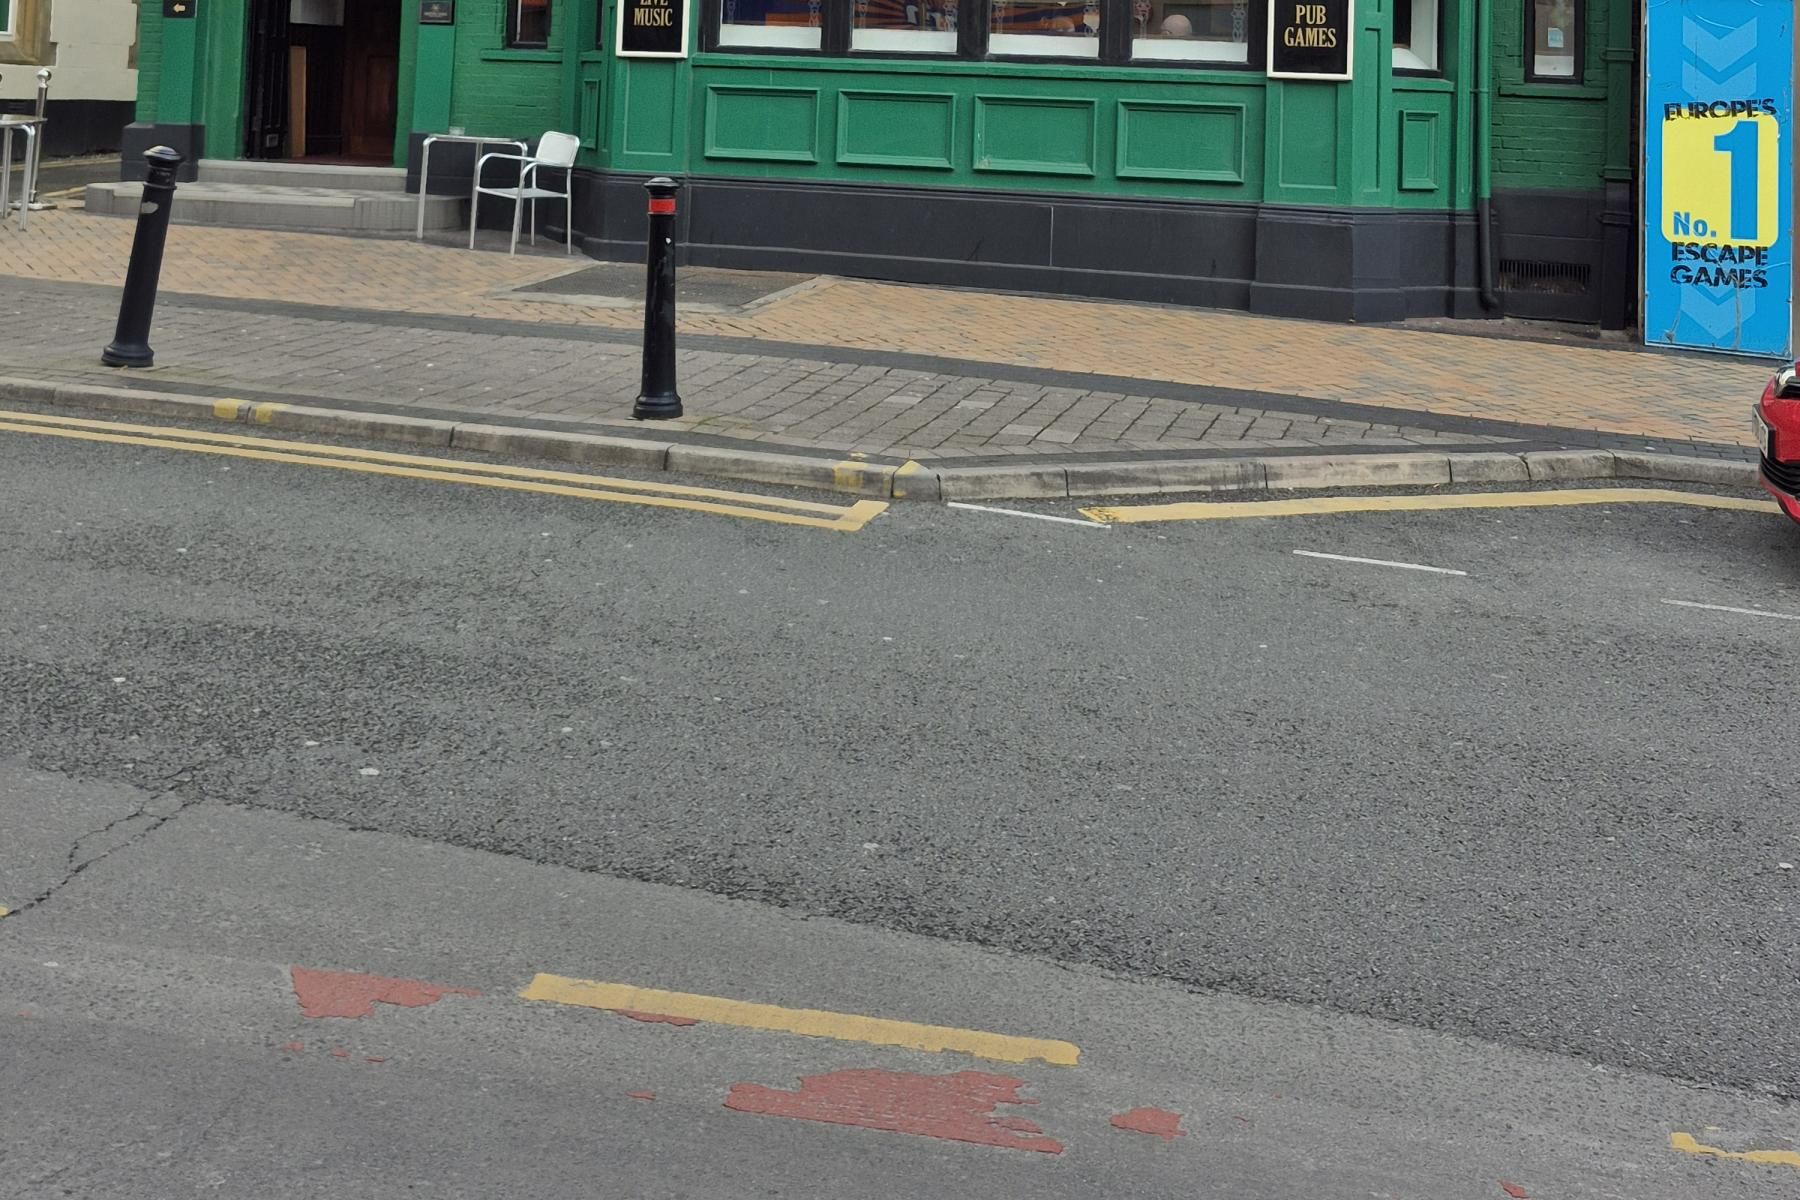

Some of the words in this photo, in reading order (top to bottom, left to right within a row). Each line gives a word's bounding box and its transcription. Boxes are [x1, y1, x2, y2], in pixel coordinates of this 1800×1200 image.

[633, 8, 673, 26] MUSIC
[1295, 4, 1327, 25] PUB
[1284, 27, 1337, 48] GAMES
[1664, 98, 1777, 121] EUROPE'S
[1673, 211, 1717, 237] No.
[1713, 120, 1759, 240] 1
[1671, 241, 1768, 266] ESCAPE
[1670, 264, 1768, 289] GAMES
